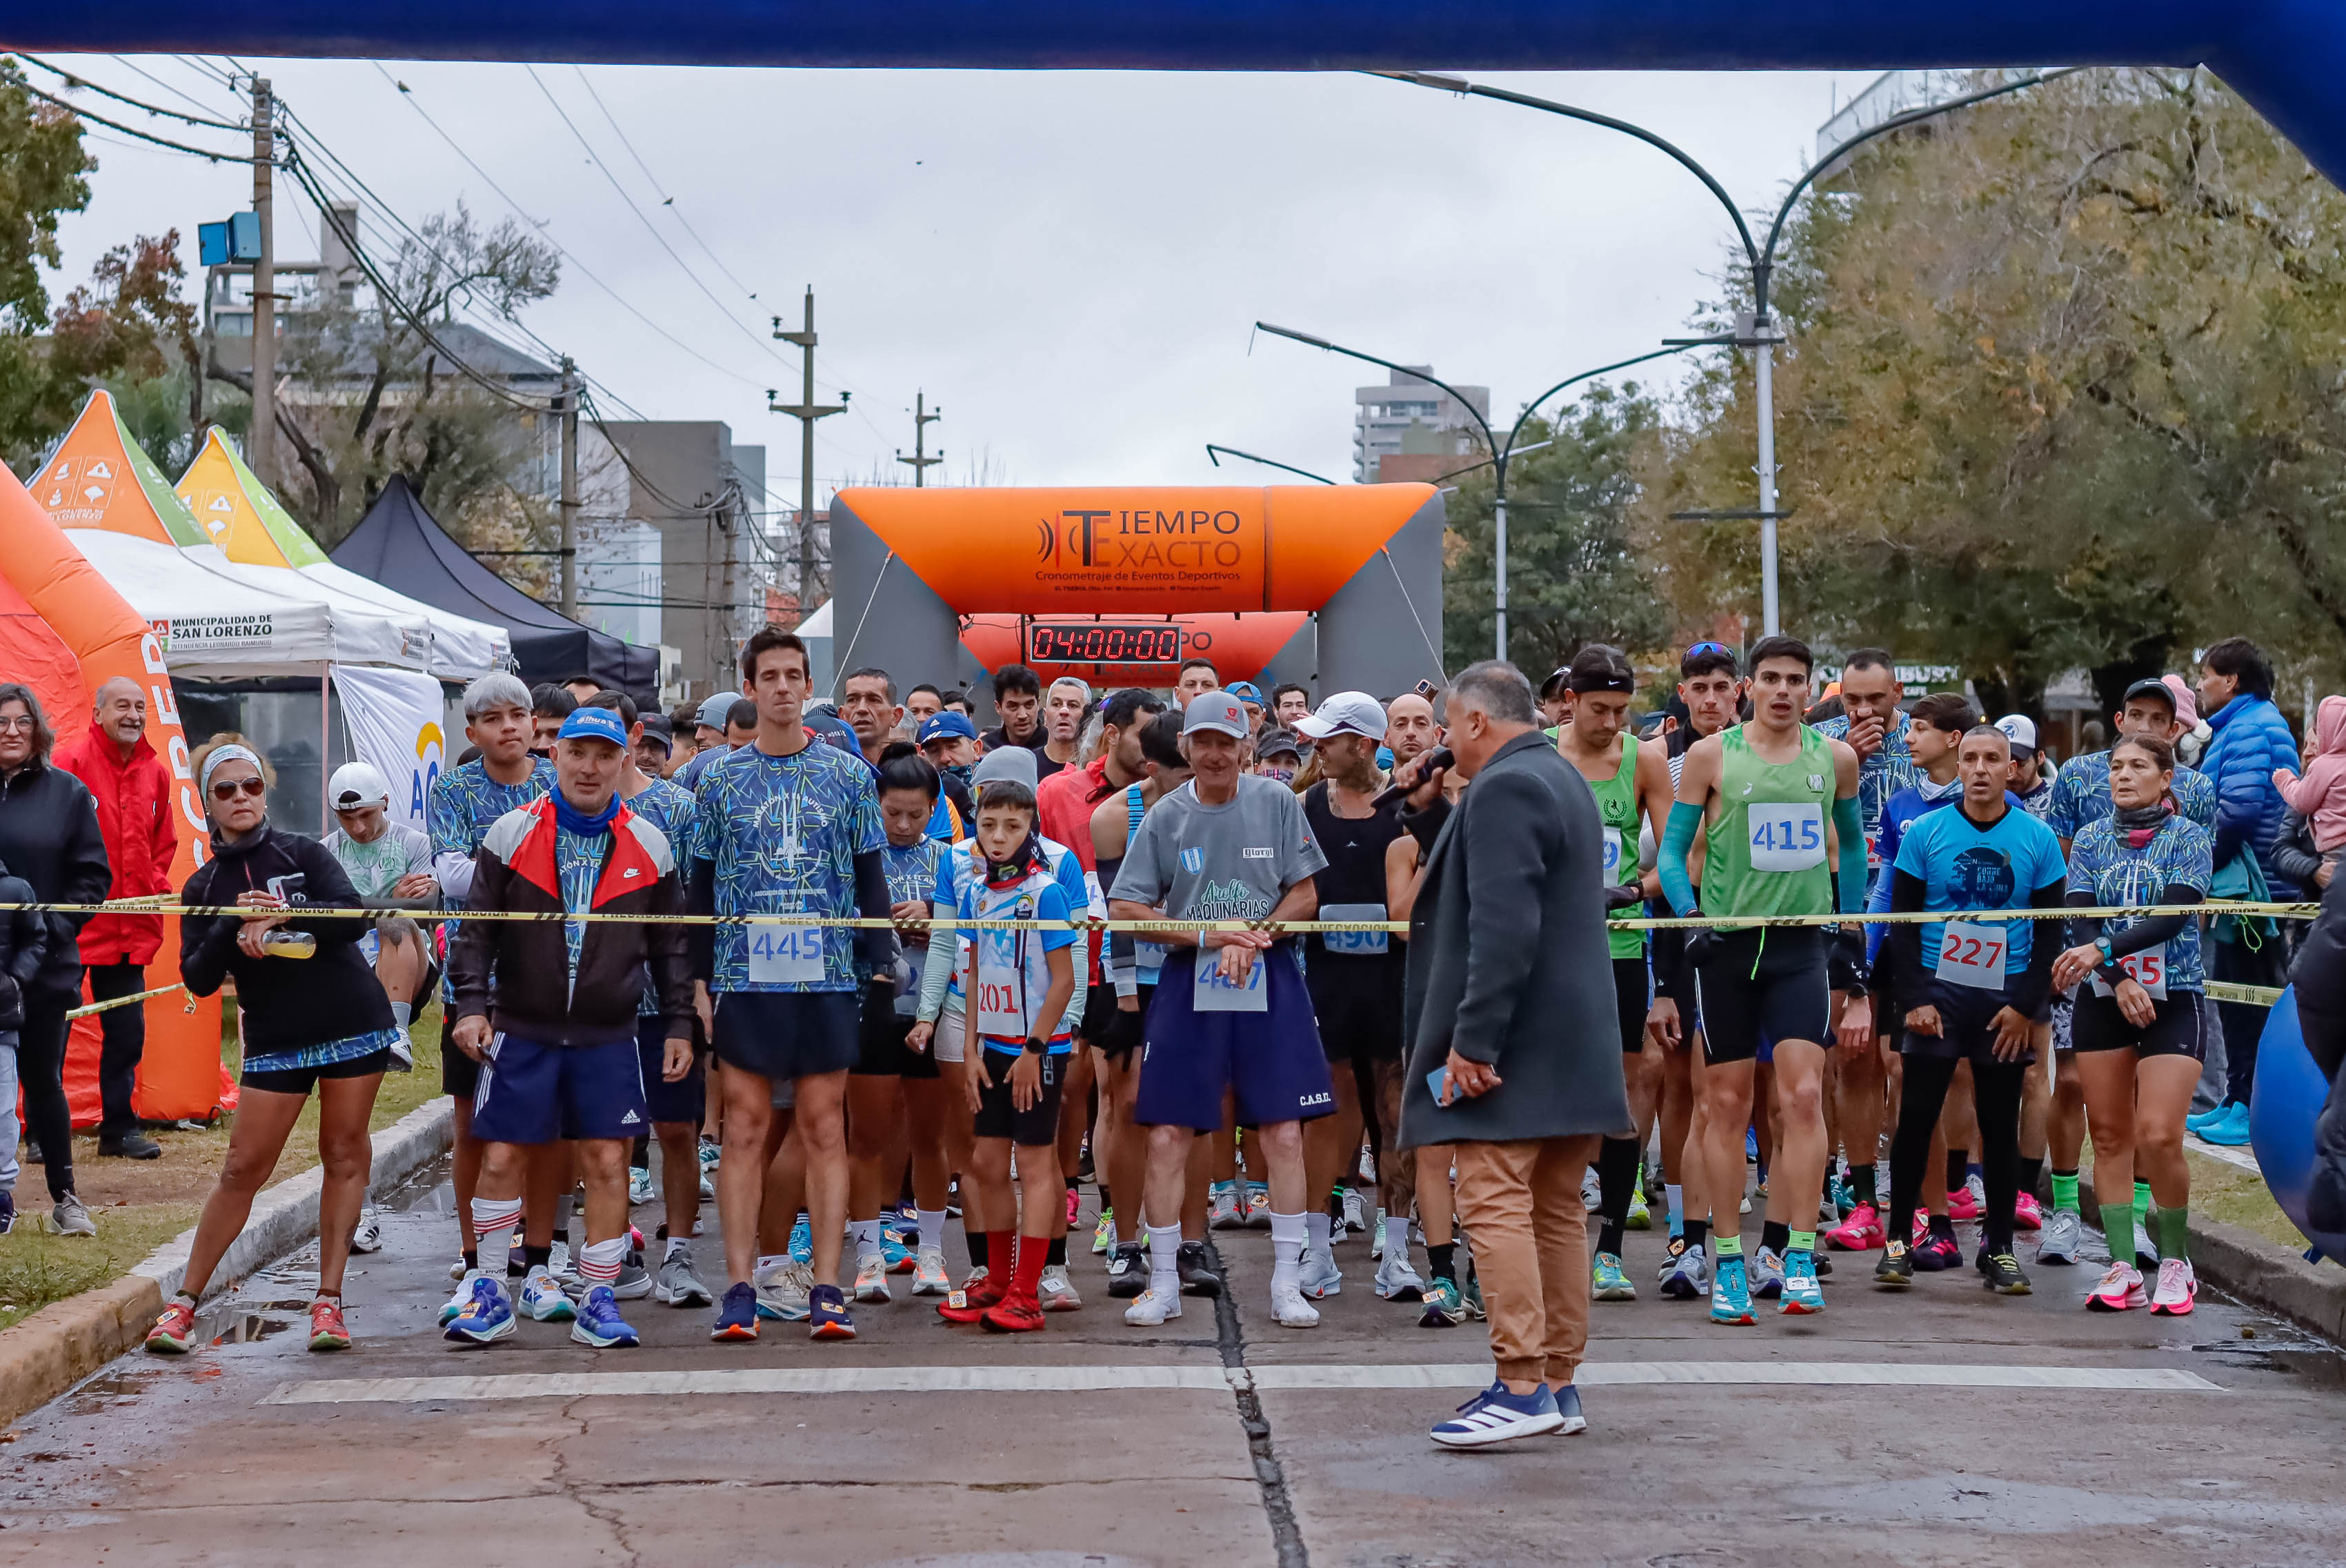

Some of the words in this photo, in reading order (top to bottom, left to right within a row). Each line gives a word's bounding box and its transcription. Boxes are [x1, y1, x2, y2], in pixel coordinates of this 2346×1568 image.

[1035, 571, 1111, 582] Cronometraje
[1115, 571, 1128, 580] de
[1132, 571, 1175, 580] Eventos
[1179, 571, 1240, 582] Deportivos
[172, 616, 255, 627] MUNICIPALIDAD
[259, 615, 272, 623] DE
[172, 628, 201, 639] SAN
[206, 624, 272, 637] LORENZO
[1034, 628, 1176, 660] 04:00:00
[1753, 820, 1820, 851] 415
[1977, 875, 1995, 883] BAJO
[1186, 900, 1269, 920] MAQUINARIAS
[753, 929, 822, 961] 445
[1942, 934, 2003, 969] 227
[2098, 955, 2161, 985] 65
[980, 982, 1019, 1014] 201
[1300, 1092, 1331, 1106] C.A.S.D.
